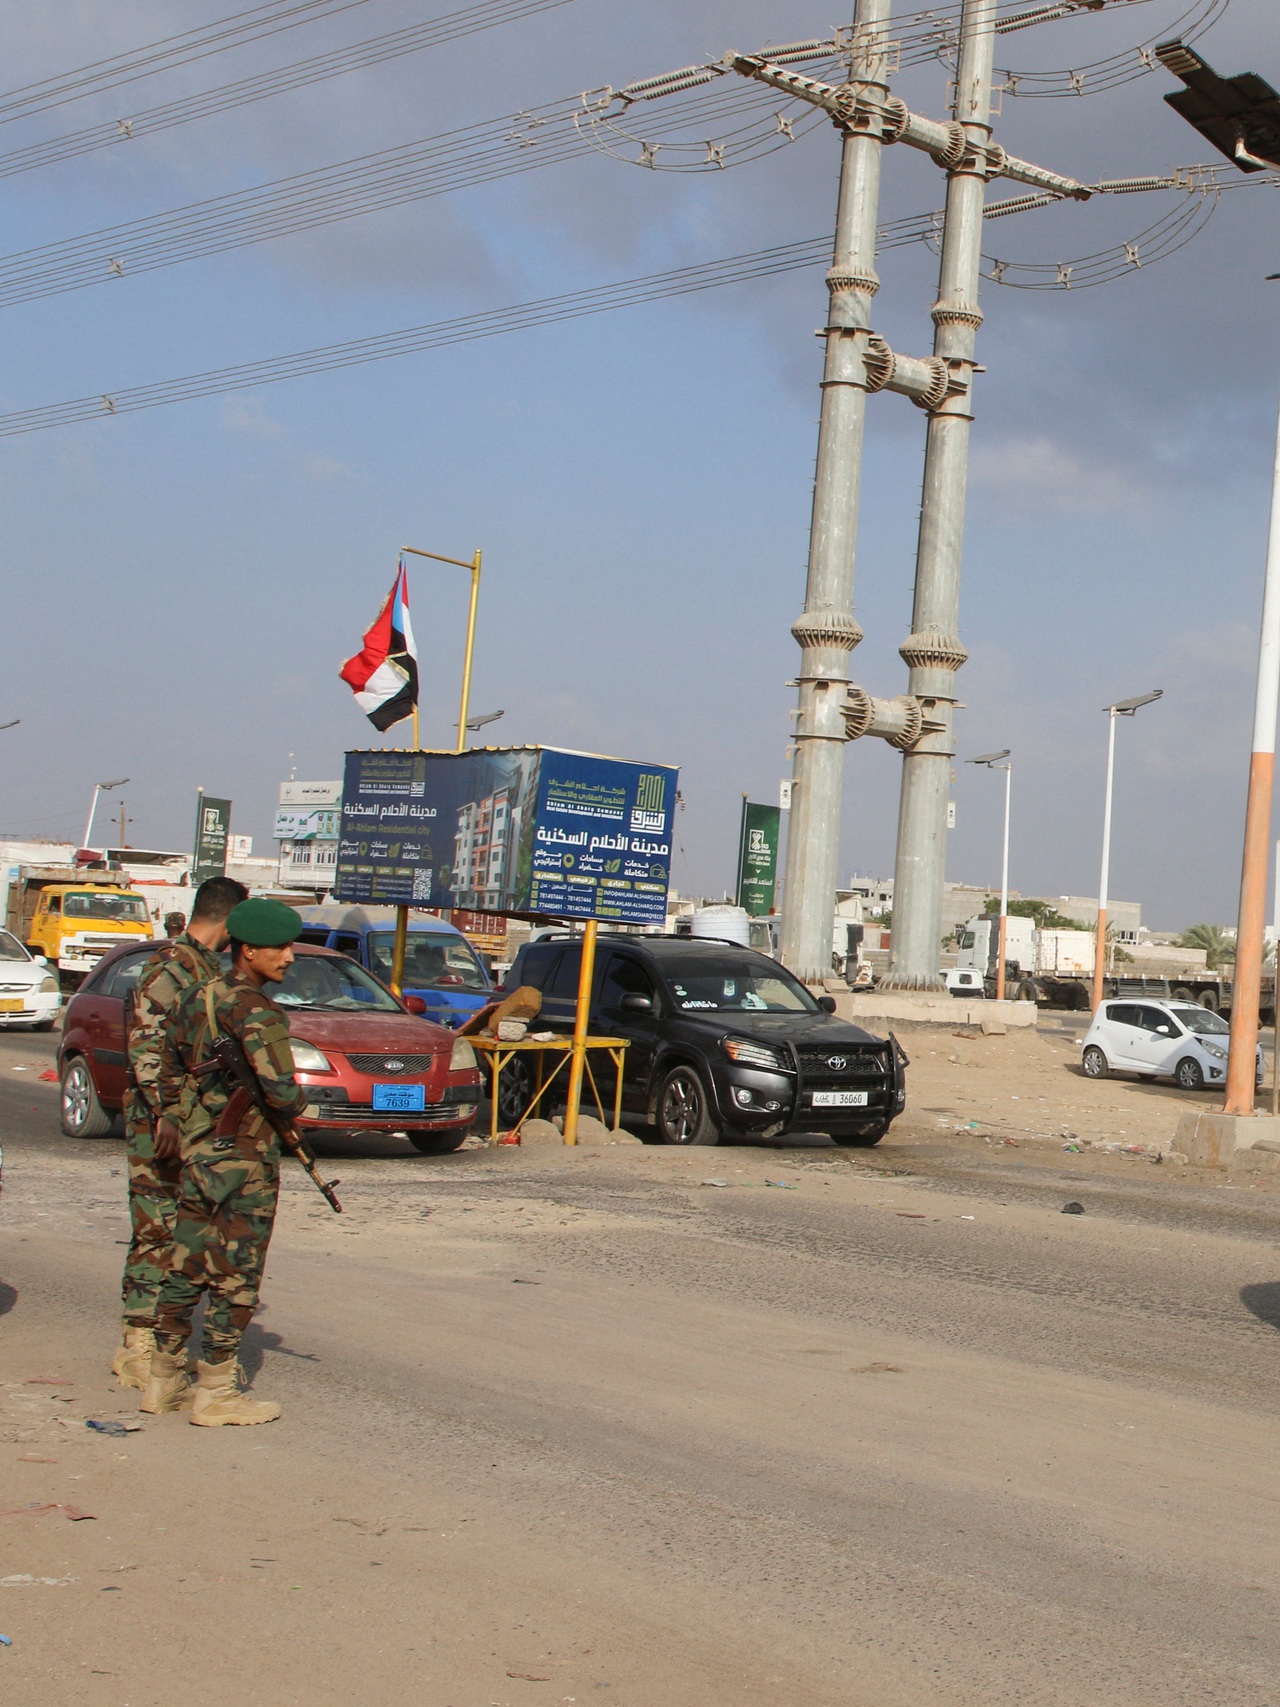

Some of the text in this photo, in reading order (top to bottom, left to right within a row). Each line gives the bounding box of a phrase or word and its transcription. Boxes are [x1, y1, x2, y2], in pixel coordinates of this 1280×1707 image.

[600, 787, 626, 796] شركة
[344, 802, 437, 820] مدينة الأحلام السكنية
[546, 800, 566, 809] Ahlam
[576, 804, 594, 812] Sharq
[597, 808, 624, 816] Company
[378, 824, 416, 834] Residential
[536, 826, 669, 858] مدينة الأحلام السكنية
[534, 848, 562, 857] موقع
[580, 854, 604, 863] مساحات
[578, 863, 603, 872] خضراء
[624, 860, 650, 868] خدمات
[624, 868, 648, 878] متكاملة
[386, 1098, 410, 1108] 7639
[840, 1094, 862, 1104] 36060
